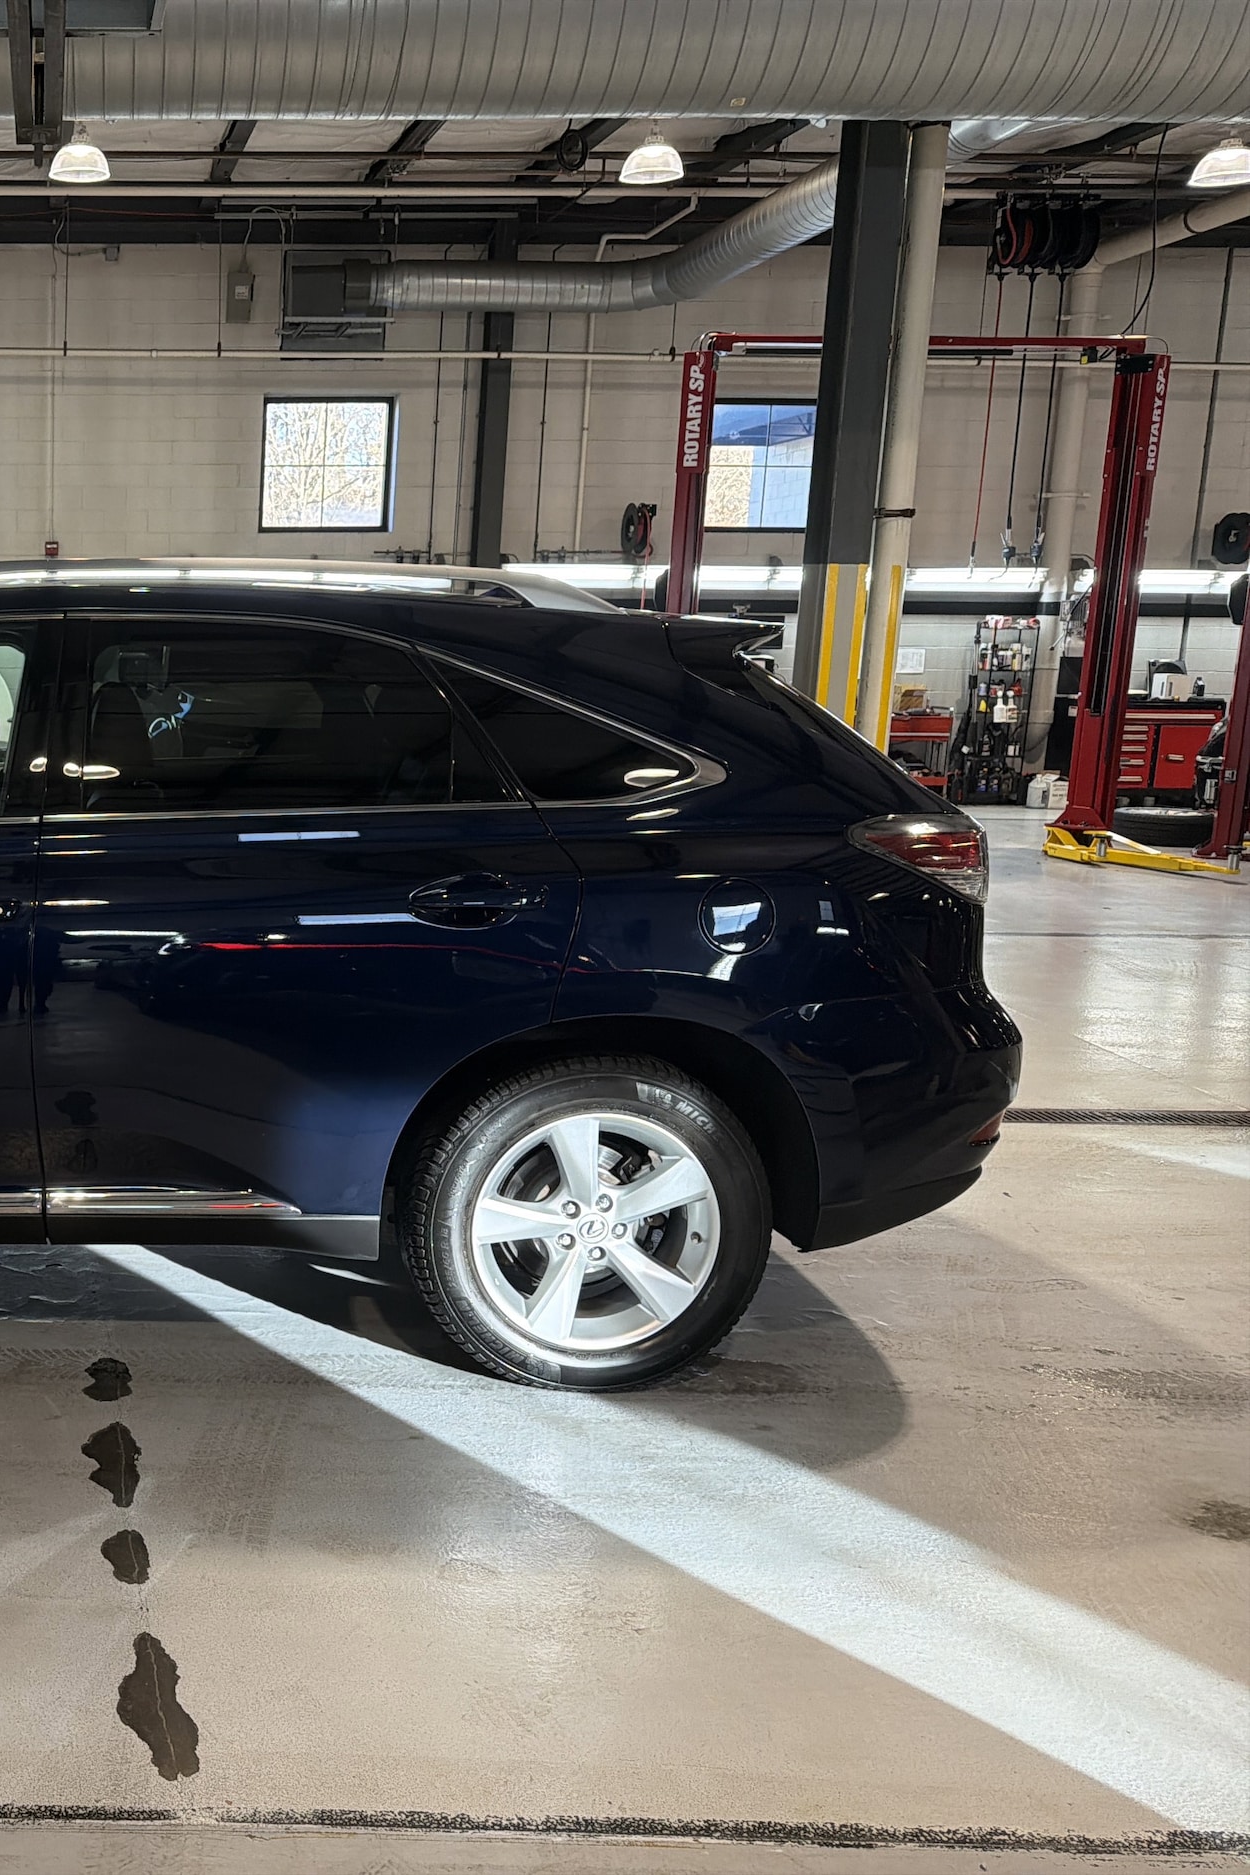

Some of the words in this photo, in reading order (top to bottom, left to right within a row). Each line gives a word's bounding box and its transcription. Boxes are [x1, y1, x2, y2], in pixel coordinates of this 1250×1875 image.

[683, 393, 703, 467] ROTARY
[1146, 396, 1163, 471] ROTARY
[454, 1299, 525, 1364] MICHELIN
